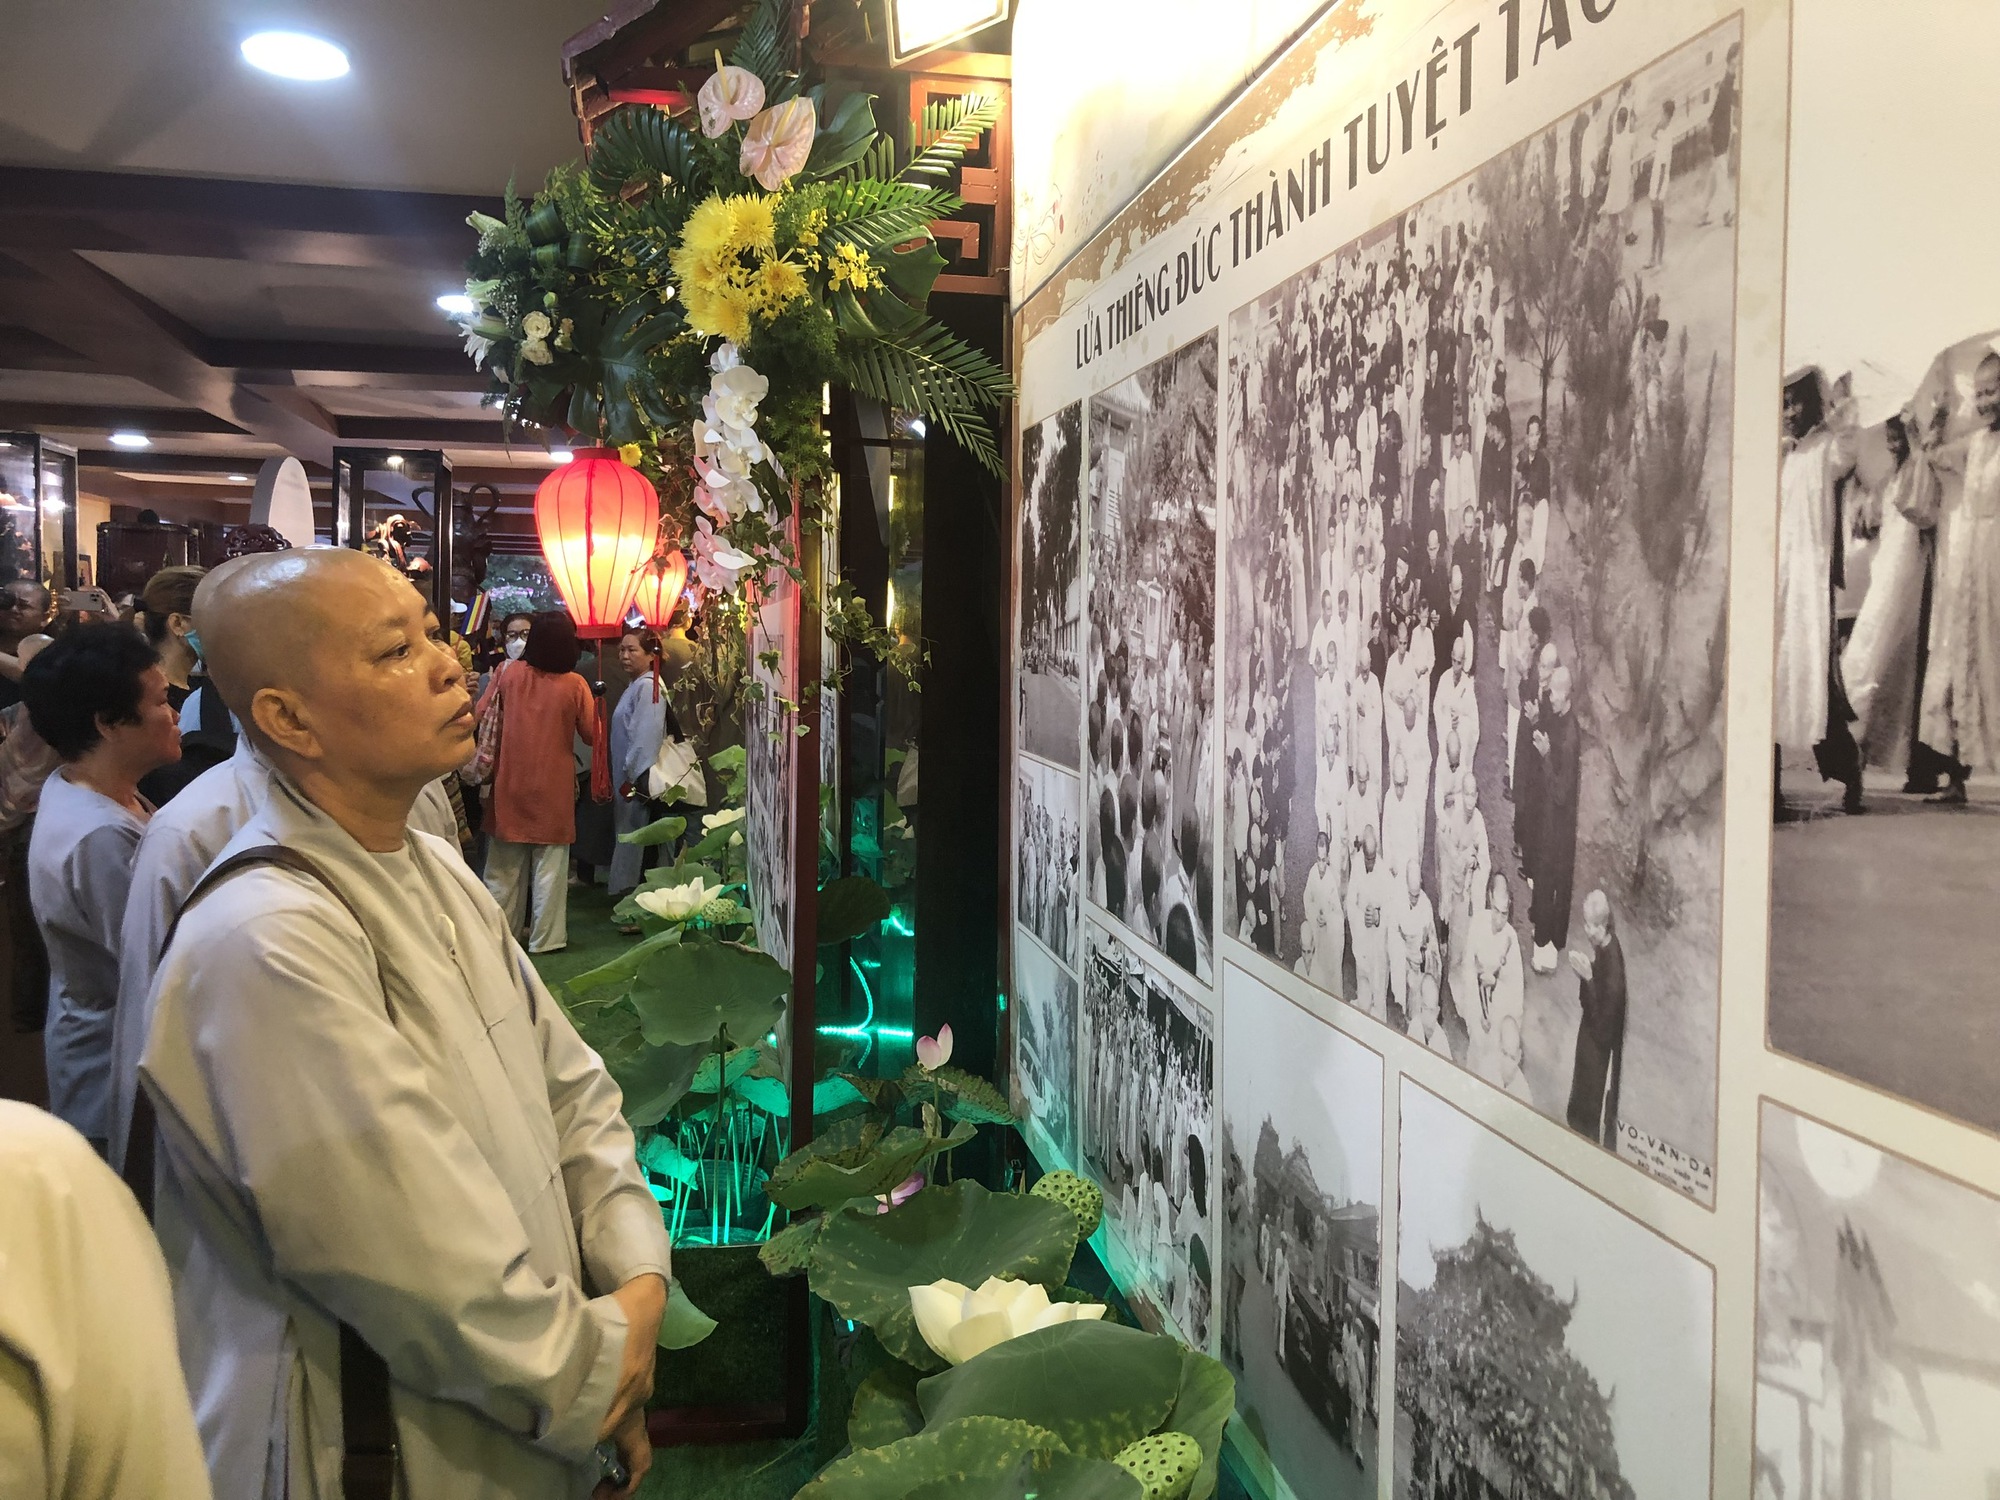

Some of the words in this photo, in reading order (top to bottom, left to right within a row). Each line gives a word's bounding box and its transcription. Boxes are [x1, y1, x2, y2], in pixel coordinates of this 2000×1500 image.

[1076, 303, 1103, 370] LỬA
[1106, 262, 1170, 351] THIÊNG
[1175, 221, 1222, 306] ĐÚC
[1229, 137, 1331, 269] THÀNH
[1343, 22, 1481, 191] TUYỆT
